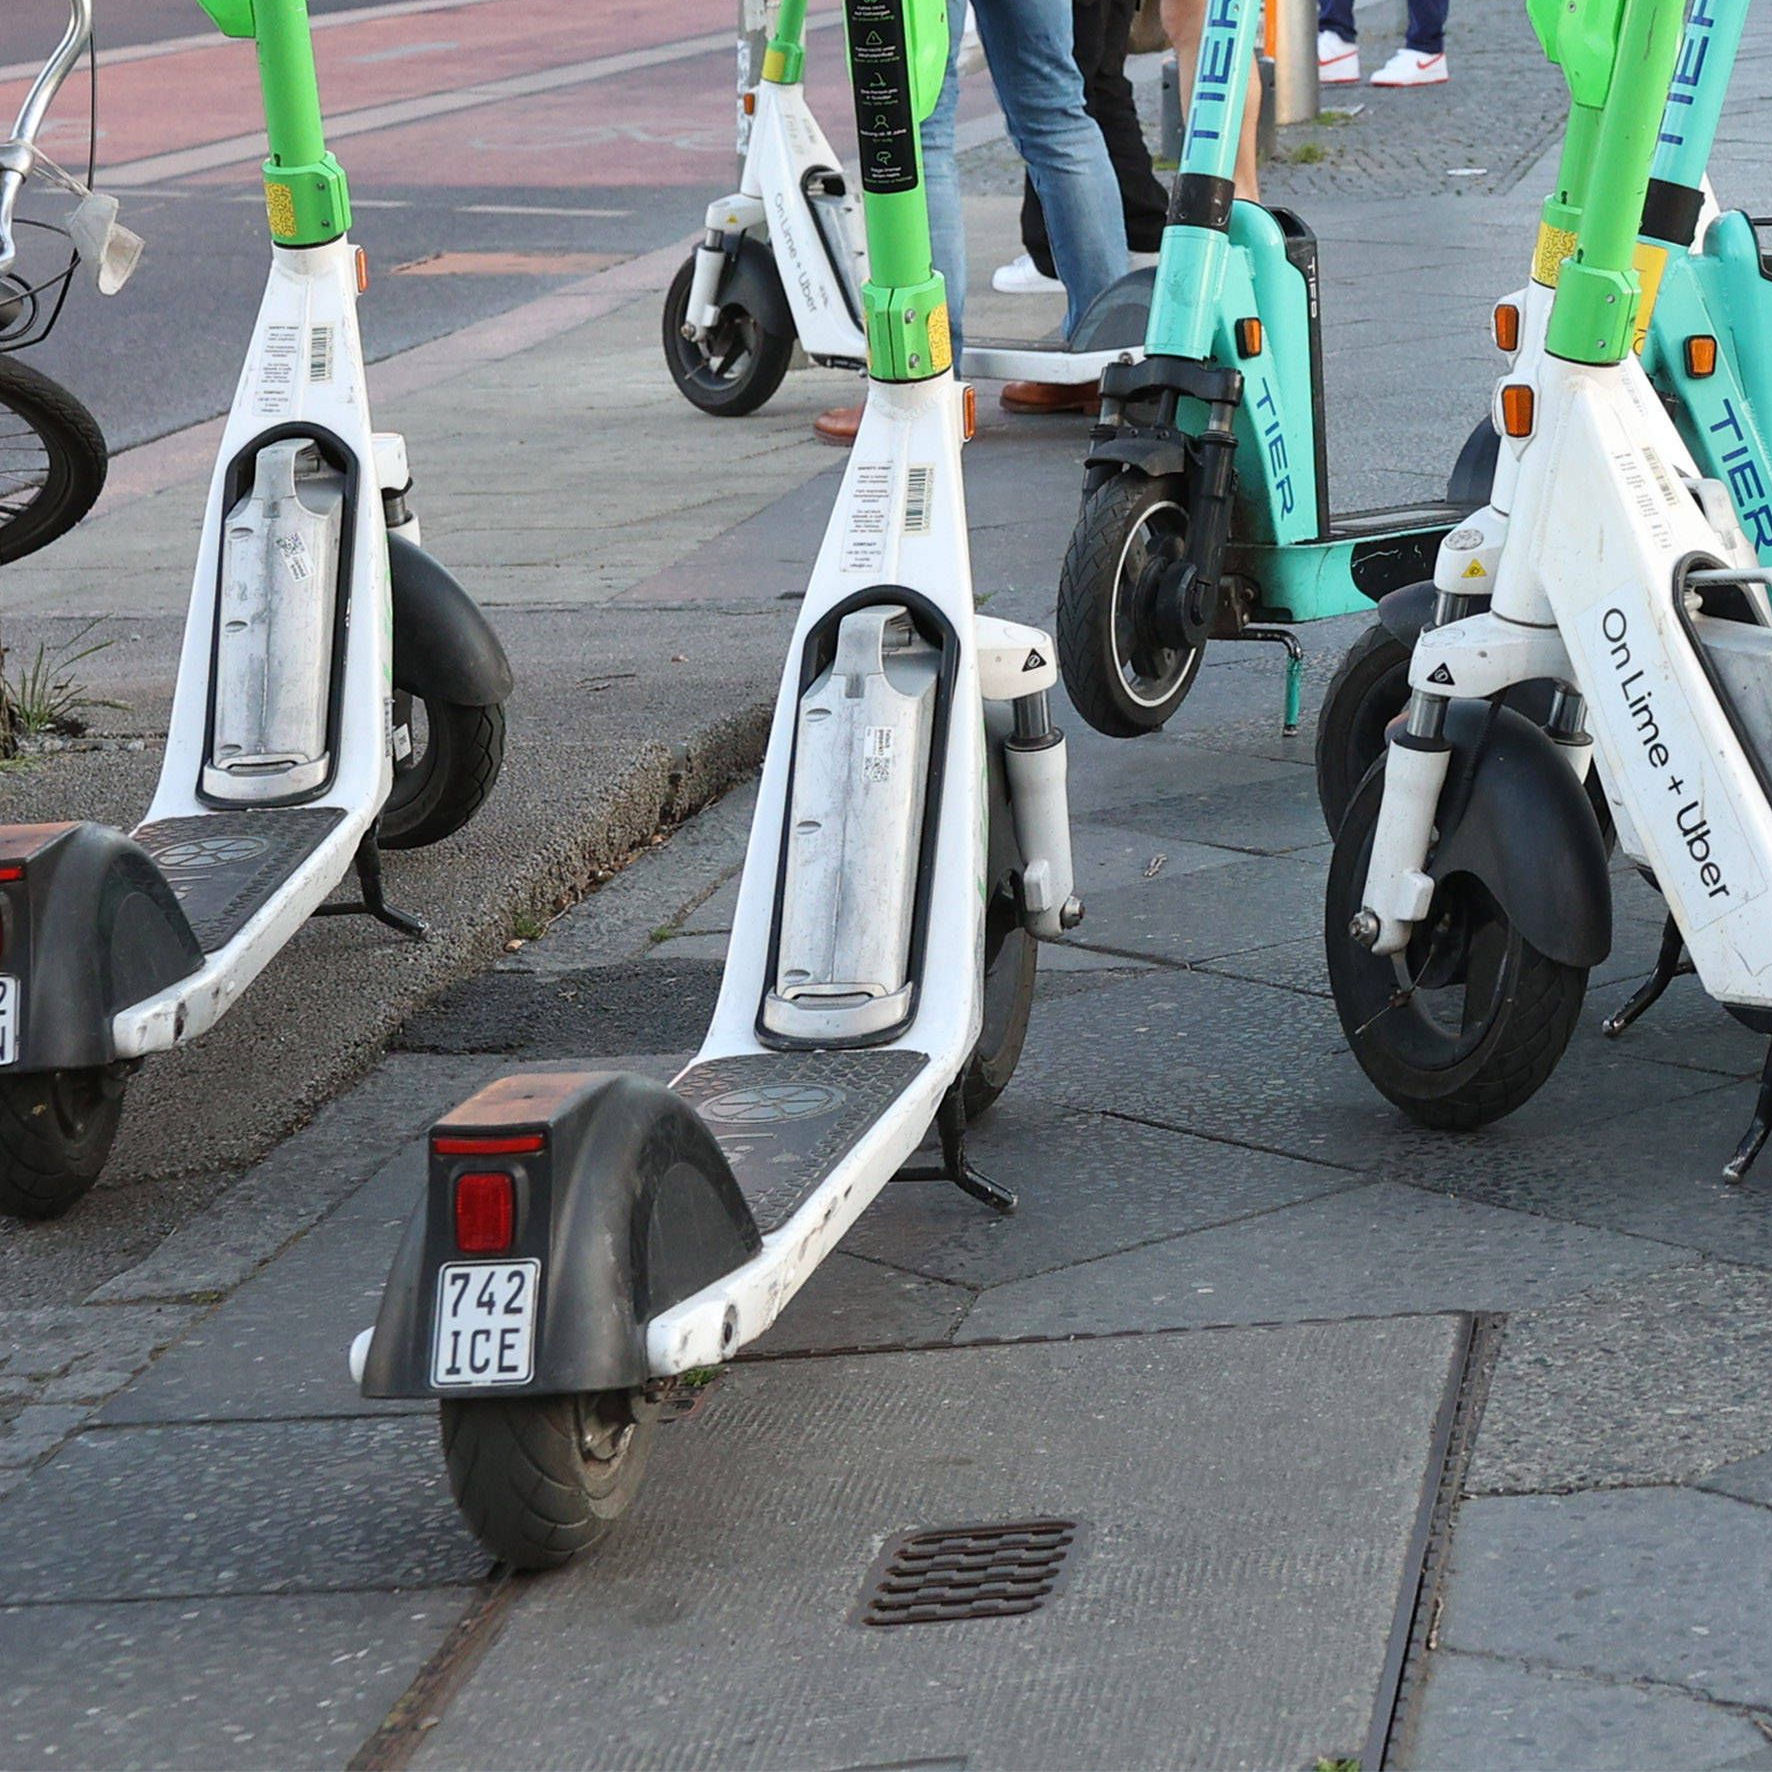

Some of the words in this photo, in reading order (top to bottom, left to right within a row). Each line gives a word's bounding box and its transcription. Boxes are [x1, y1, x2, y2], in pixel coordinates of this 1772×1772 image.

[781, 218, 798, 259] Lime
[799, 271, 817, 312] Uber
[1255, 377, 1296, 521] TIER
[1602, 607, 1632, 666] On
[1619, 668, 1671, 770] Lime
[1676, 802, 1732, 902] Uber
[448, 1268, 526, 1317] 742
[443, 1327, 523, 1377] ICE
